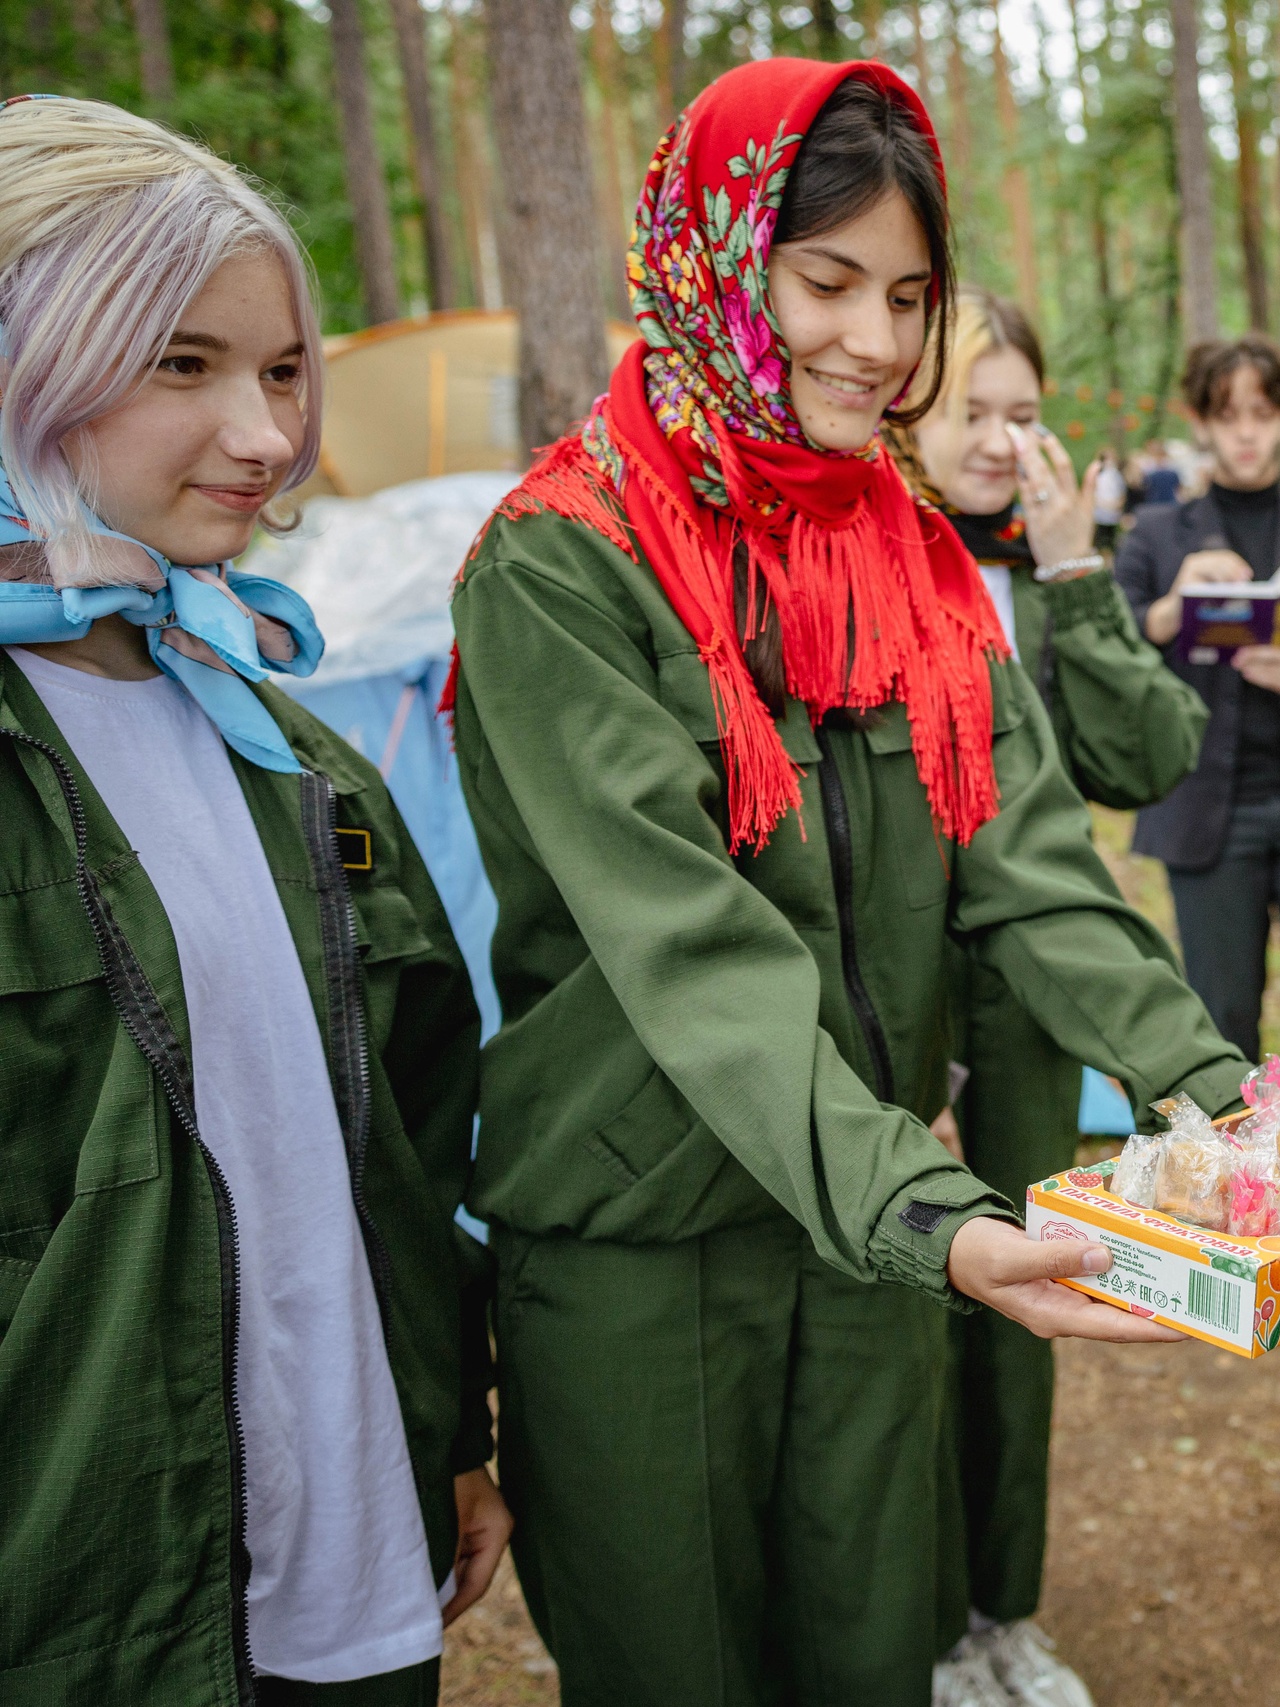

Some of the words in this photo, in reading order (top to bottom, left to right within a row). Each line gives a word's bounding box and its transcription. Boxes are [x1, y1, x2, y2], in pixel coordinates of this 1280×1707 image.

[1060, 1188, 1141, 1218] ПАСТИЛА
[1143, 1217, 1253, 1257] ФРУКТОВАЯ
[1099, 1234, 1110, 1242] ООО
